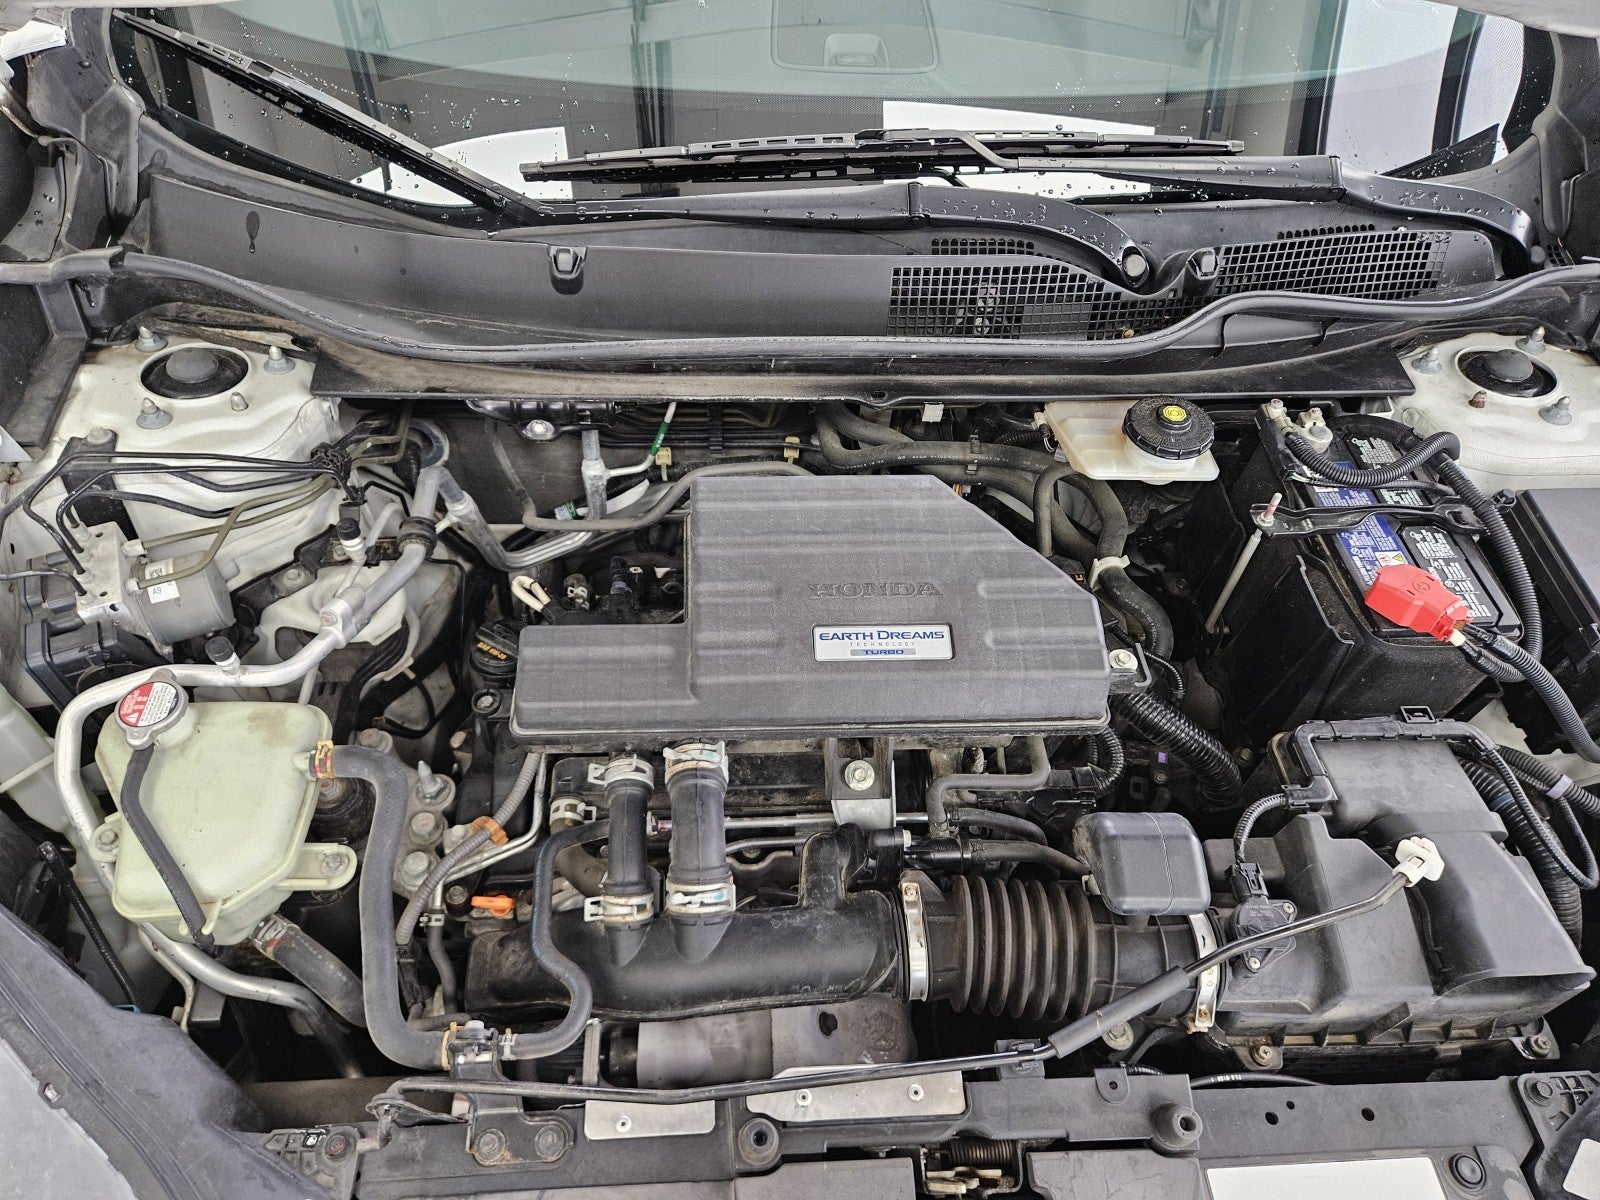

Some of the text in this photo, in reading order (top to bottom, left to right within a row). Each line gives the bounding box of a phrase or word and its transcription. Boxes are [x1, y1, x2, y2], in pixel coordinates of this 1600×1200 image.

[809, 582, 943, 598] HONDA
[819, 630, 945, 640] EARTH DREAMS
